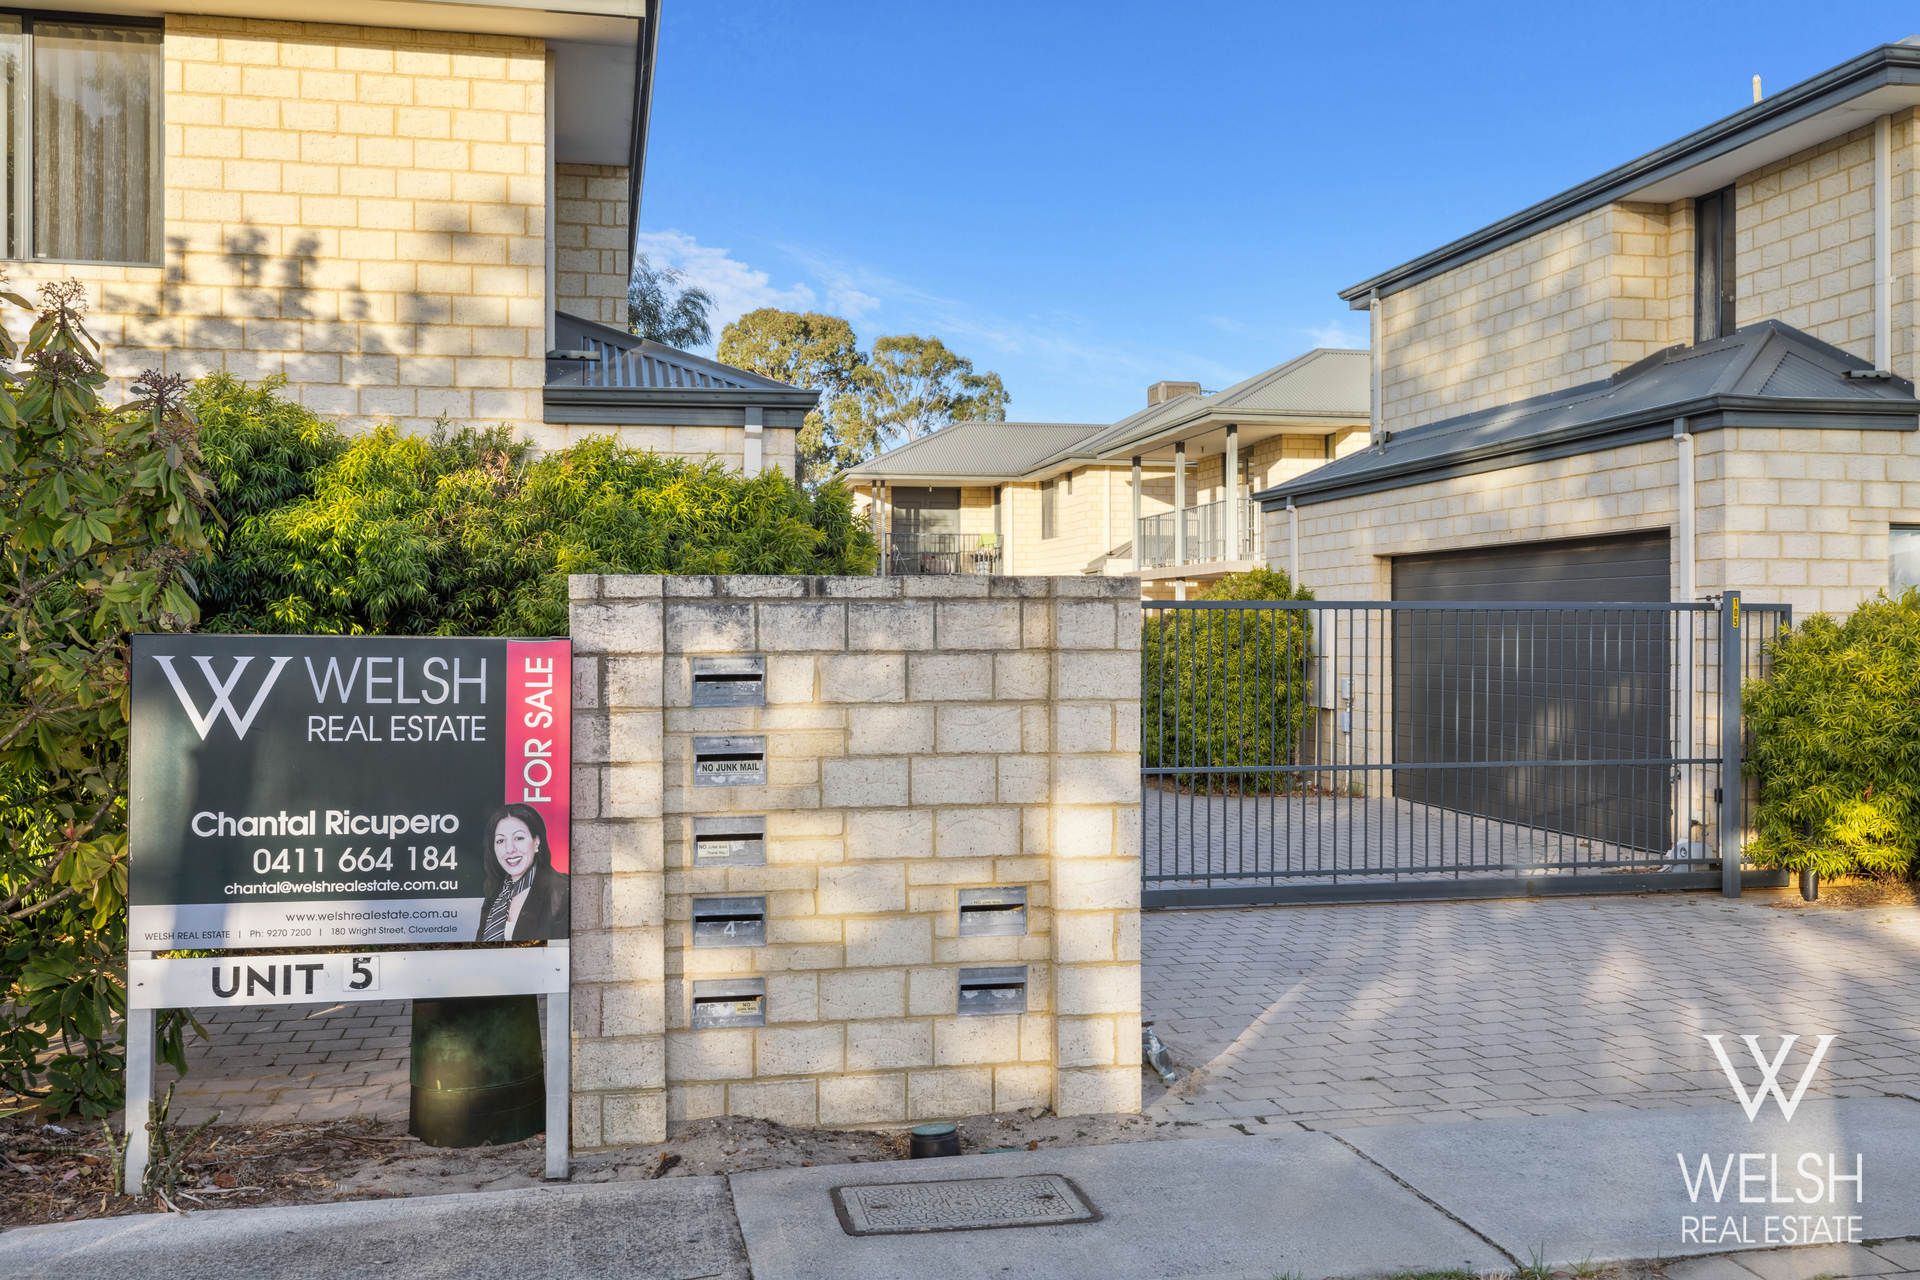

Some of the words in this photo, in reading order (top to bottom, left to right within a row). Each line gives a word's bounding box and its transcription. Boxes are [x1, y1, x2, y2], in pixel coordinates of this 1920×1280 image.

[304, 656, 487, 706] WELSH
[524, 656, 554, 729] SALE
[308, 715, 382, 742] REAL
[390, 715, 487, 742] ESTATE
[523, 738, 552, 803] FOR
[702, 763, 714, 772] NO
[716, 763, 738, 772] JUNK
[740, 762, 760, 771] MAIL
[191, 810, 316, 837] Chantal
[325, 809, 460, 840] Ricupero
[253, 847, 324, 875] 0411
[338, 847, 394, 873] 664
[407, 845, 459, 872] 184
[224, 879, 459, 895] chantal@welshrealestate.com.au
[285, 909, 458, 922] www.welshrealestate.com.au
[724, 920, 737, 938] 4
[144, 932, 175, 941] WELSH
[177, 931, 200, 940] REAL
[202, 930, 231, 940] ESTATE
[249, 929, 264, 939] Ph:
[266, 928, 288, 938] 9270
[291, 928, 312, 938] 7200
[331, 926, 346, 936] 180
[349, 926, 377, 937] Wright
[378, 925, 406, 936] Street,
[408, 924, 458, 935] Cloverdale
[212, 963, 324, 999] UNIT
[349, 957, 373, 990] 5
